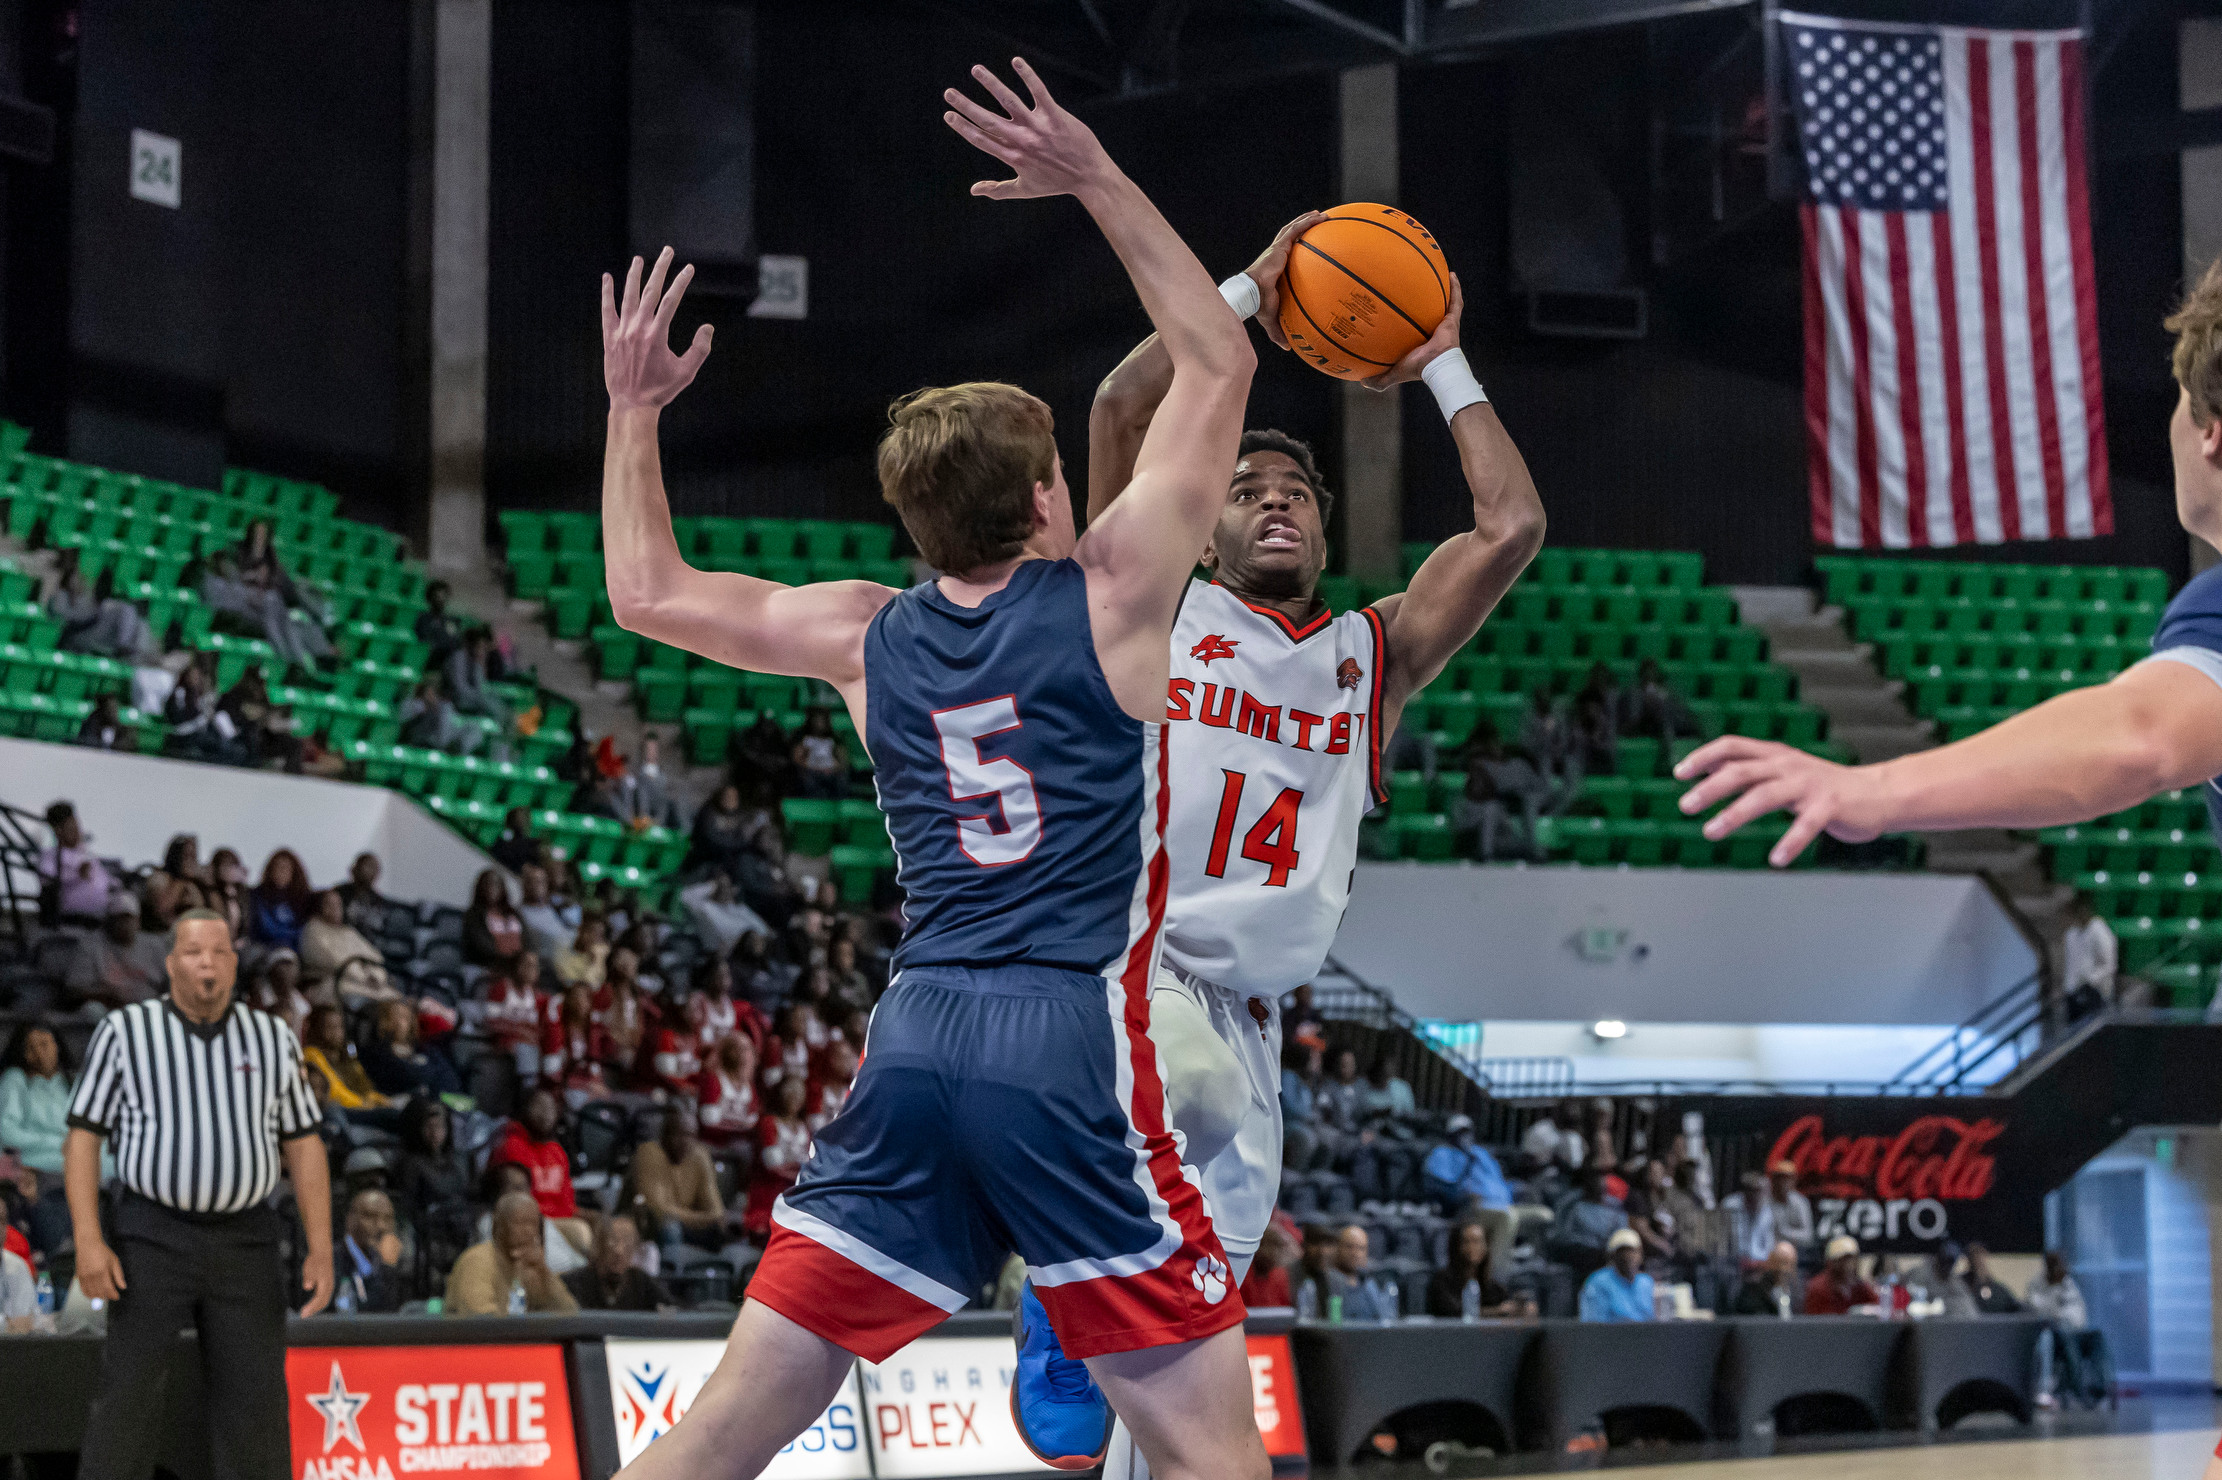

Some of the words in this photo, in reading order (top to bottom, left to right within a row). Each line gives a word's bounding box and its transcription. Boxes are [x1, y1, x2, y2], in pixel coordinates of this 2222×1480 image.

[140, 148, 173, 186] 24
[1166, 677, 1366, 755] SUMTE
[931, 693, 1044, 868] 5
[1204, 767, 1305, 888] 14
[1766, 1114, 2005, 1200] Coca-Cola
[1816, 1198, 1948, 1241] zero
[395, 1381, 546, 1446] STATE
[302, 1455, 396, 1480] AHSAA
[399, 1442, 551, 1473] CHAMPIONSHIP
